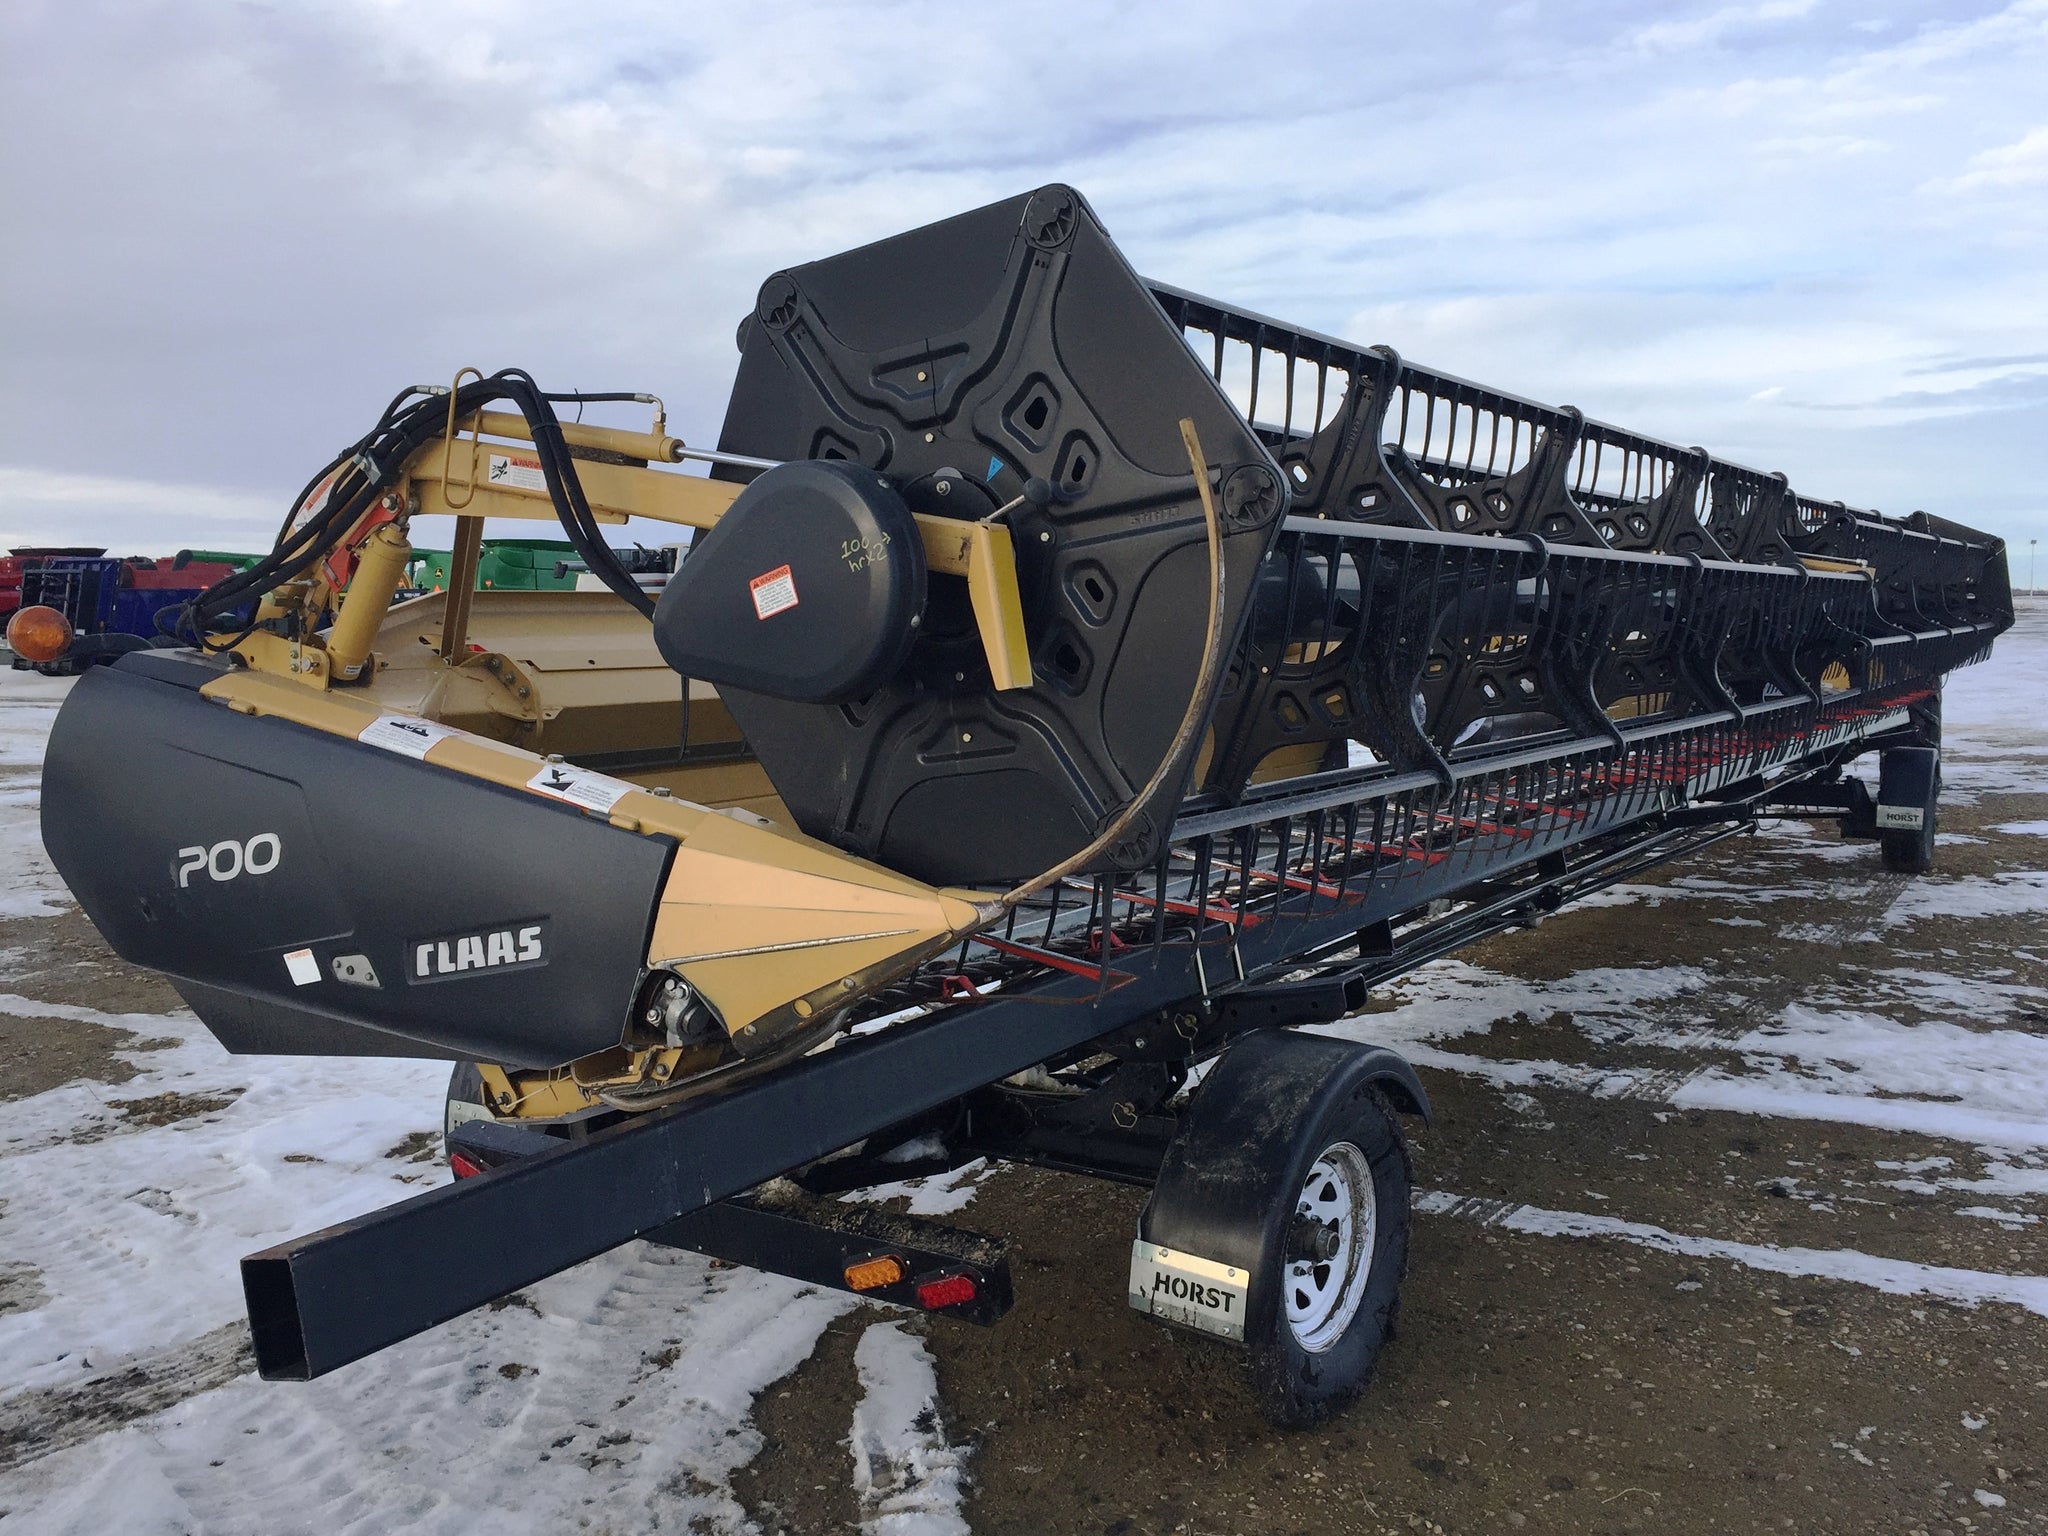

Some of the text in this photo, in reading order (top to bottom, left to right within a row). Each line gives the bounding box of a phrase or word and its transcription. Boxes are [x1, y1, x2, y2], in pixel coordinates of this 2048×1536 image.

[841, 536, 870, 559] 100
[1886, 813, 1920, 822] HORST
[416, 926, 542, 977] CLAAS
[1154, 1271, 1236, 1313] HORST
